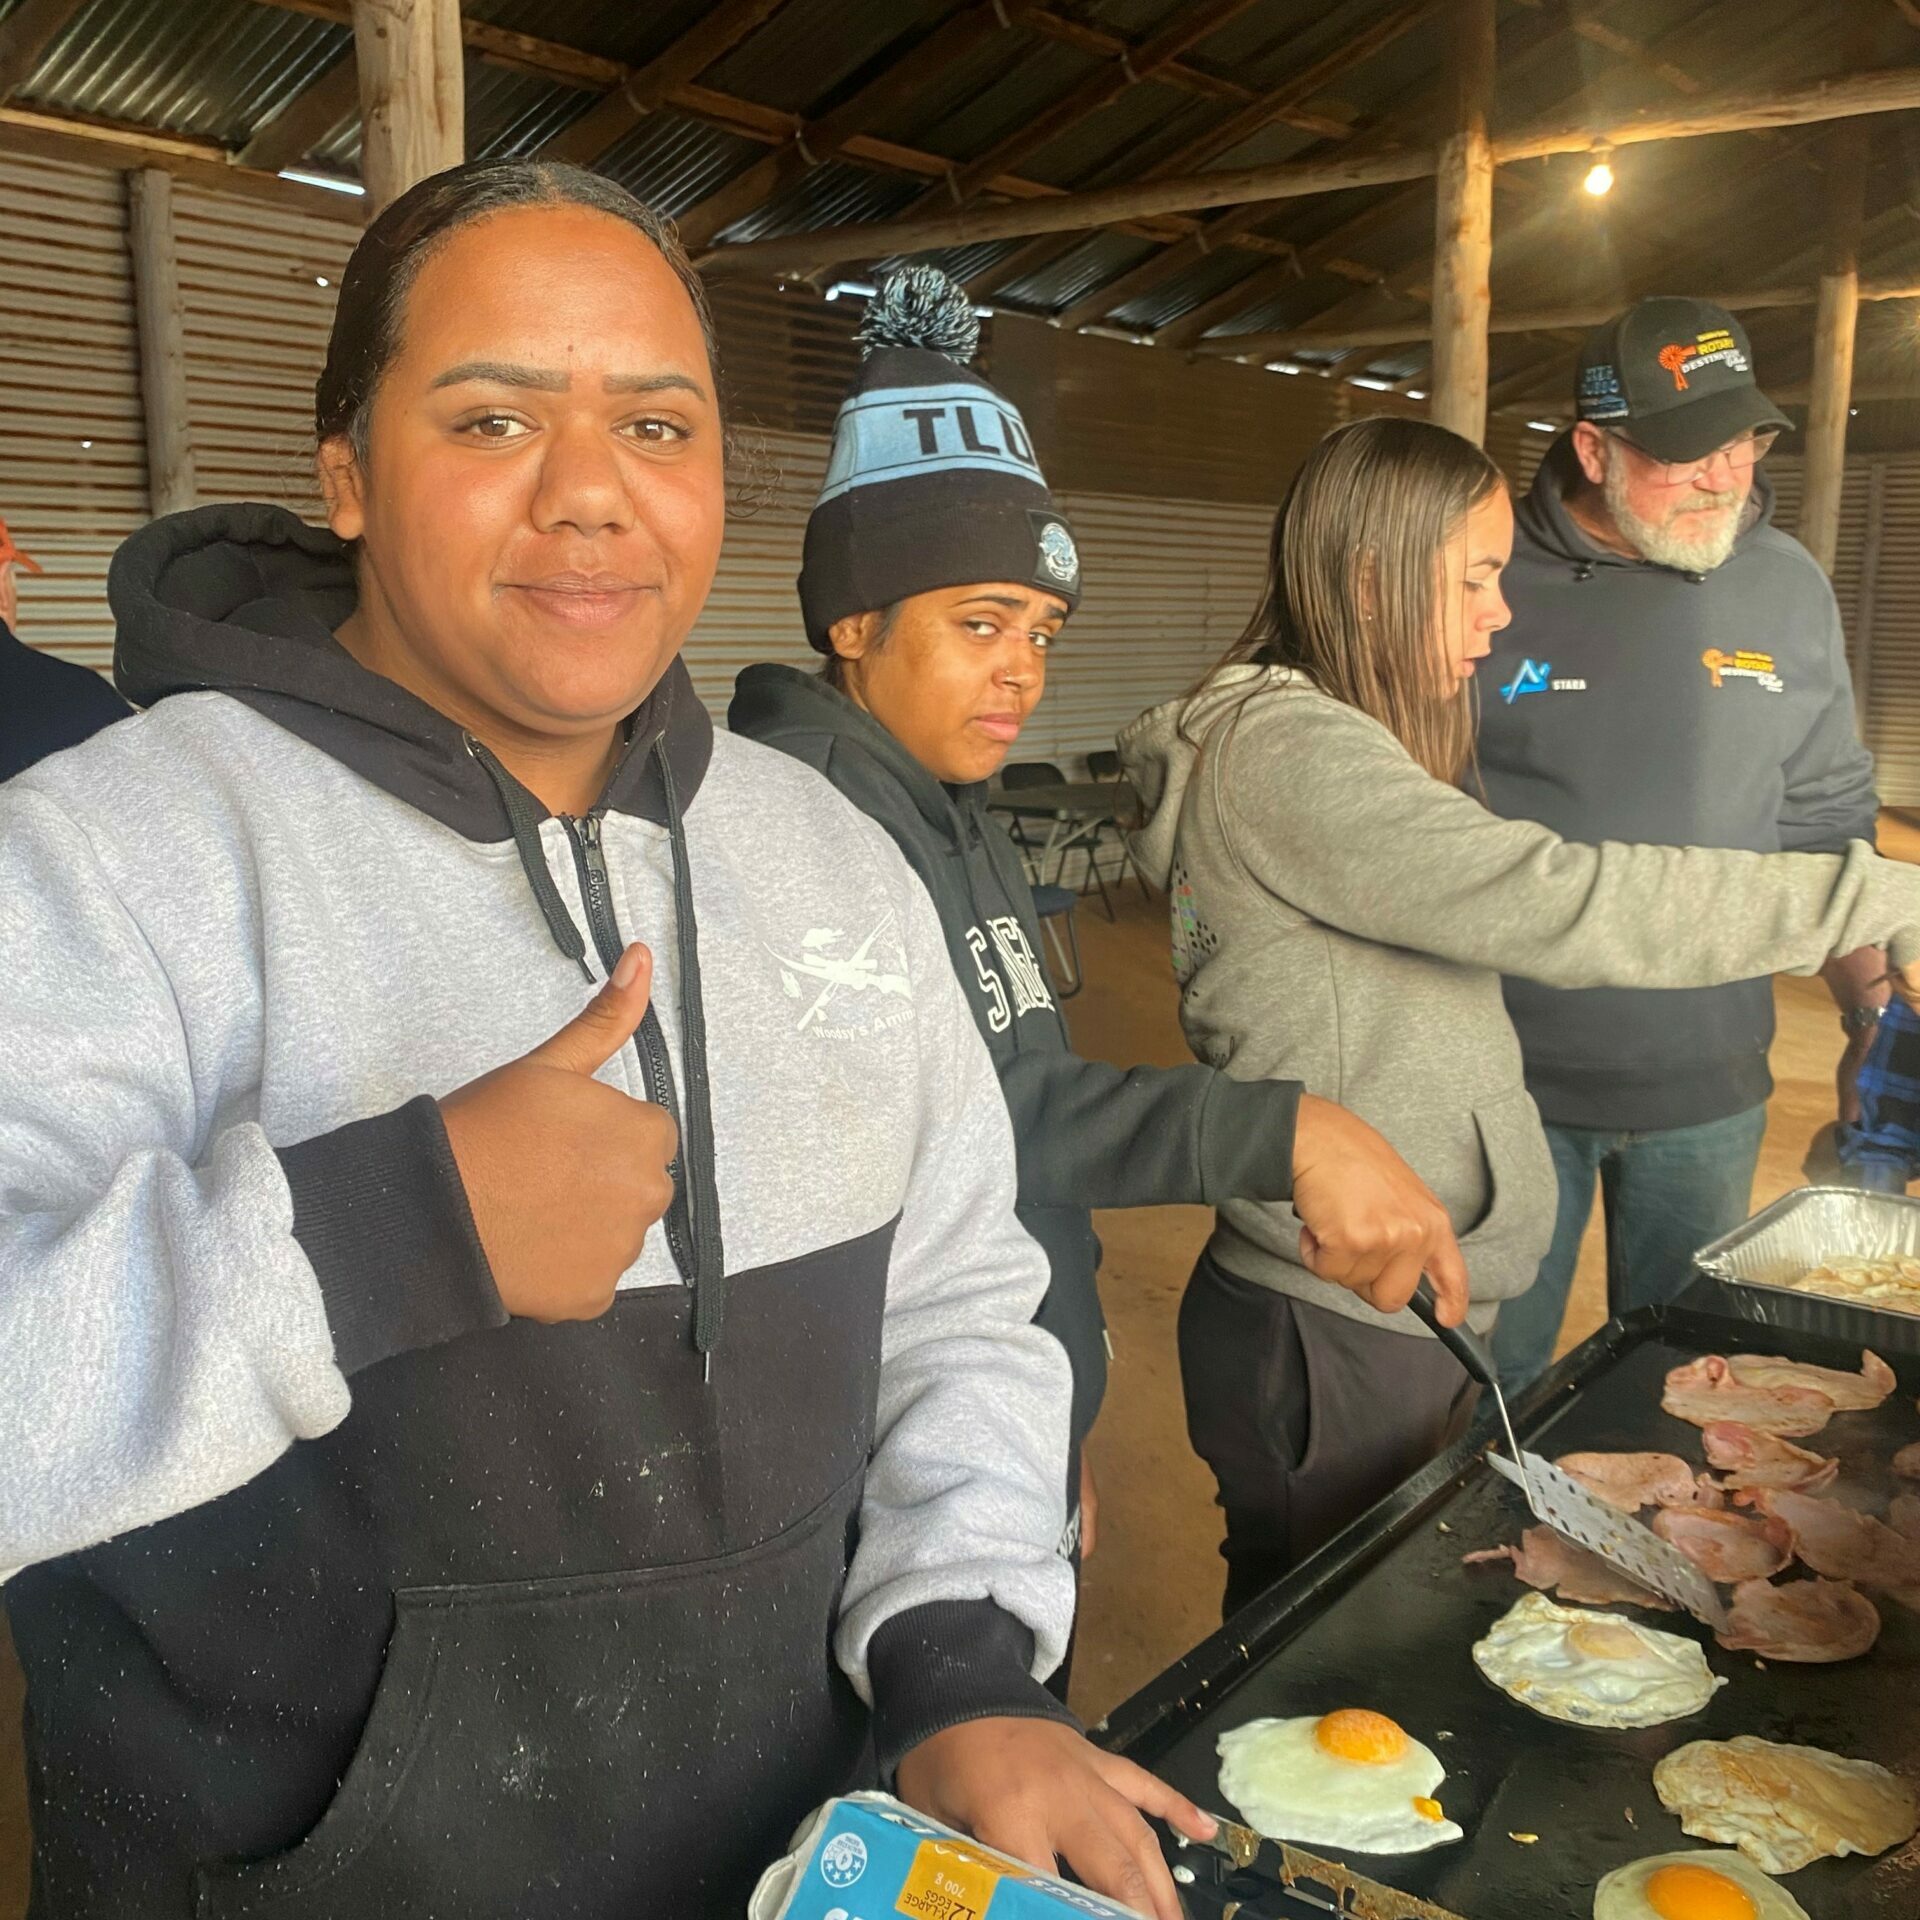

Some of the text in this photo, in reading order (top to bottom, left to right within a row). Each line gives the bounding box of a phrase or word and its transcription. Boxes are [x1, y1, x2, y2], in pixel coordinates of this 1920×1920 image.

[1698, 338, 1735, 355] ROTARY
[812, 1024, 869, 1042] Woodsy's
[934, 1872, 966, 1899] 700 g
[904, 1892, 948, 1920] X-LARGE
[924, 1889, 953, 1910] EGGS
[1027, 1879, 1117, 1917] EGGS
